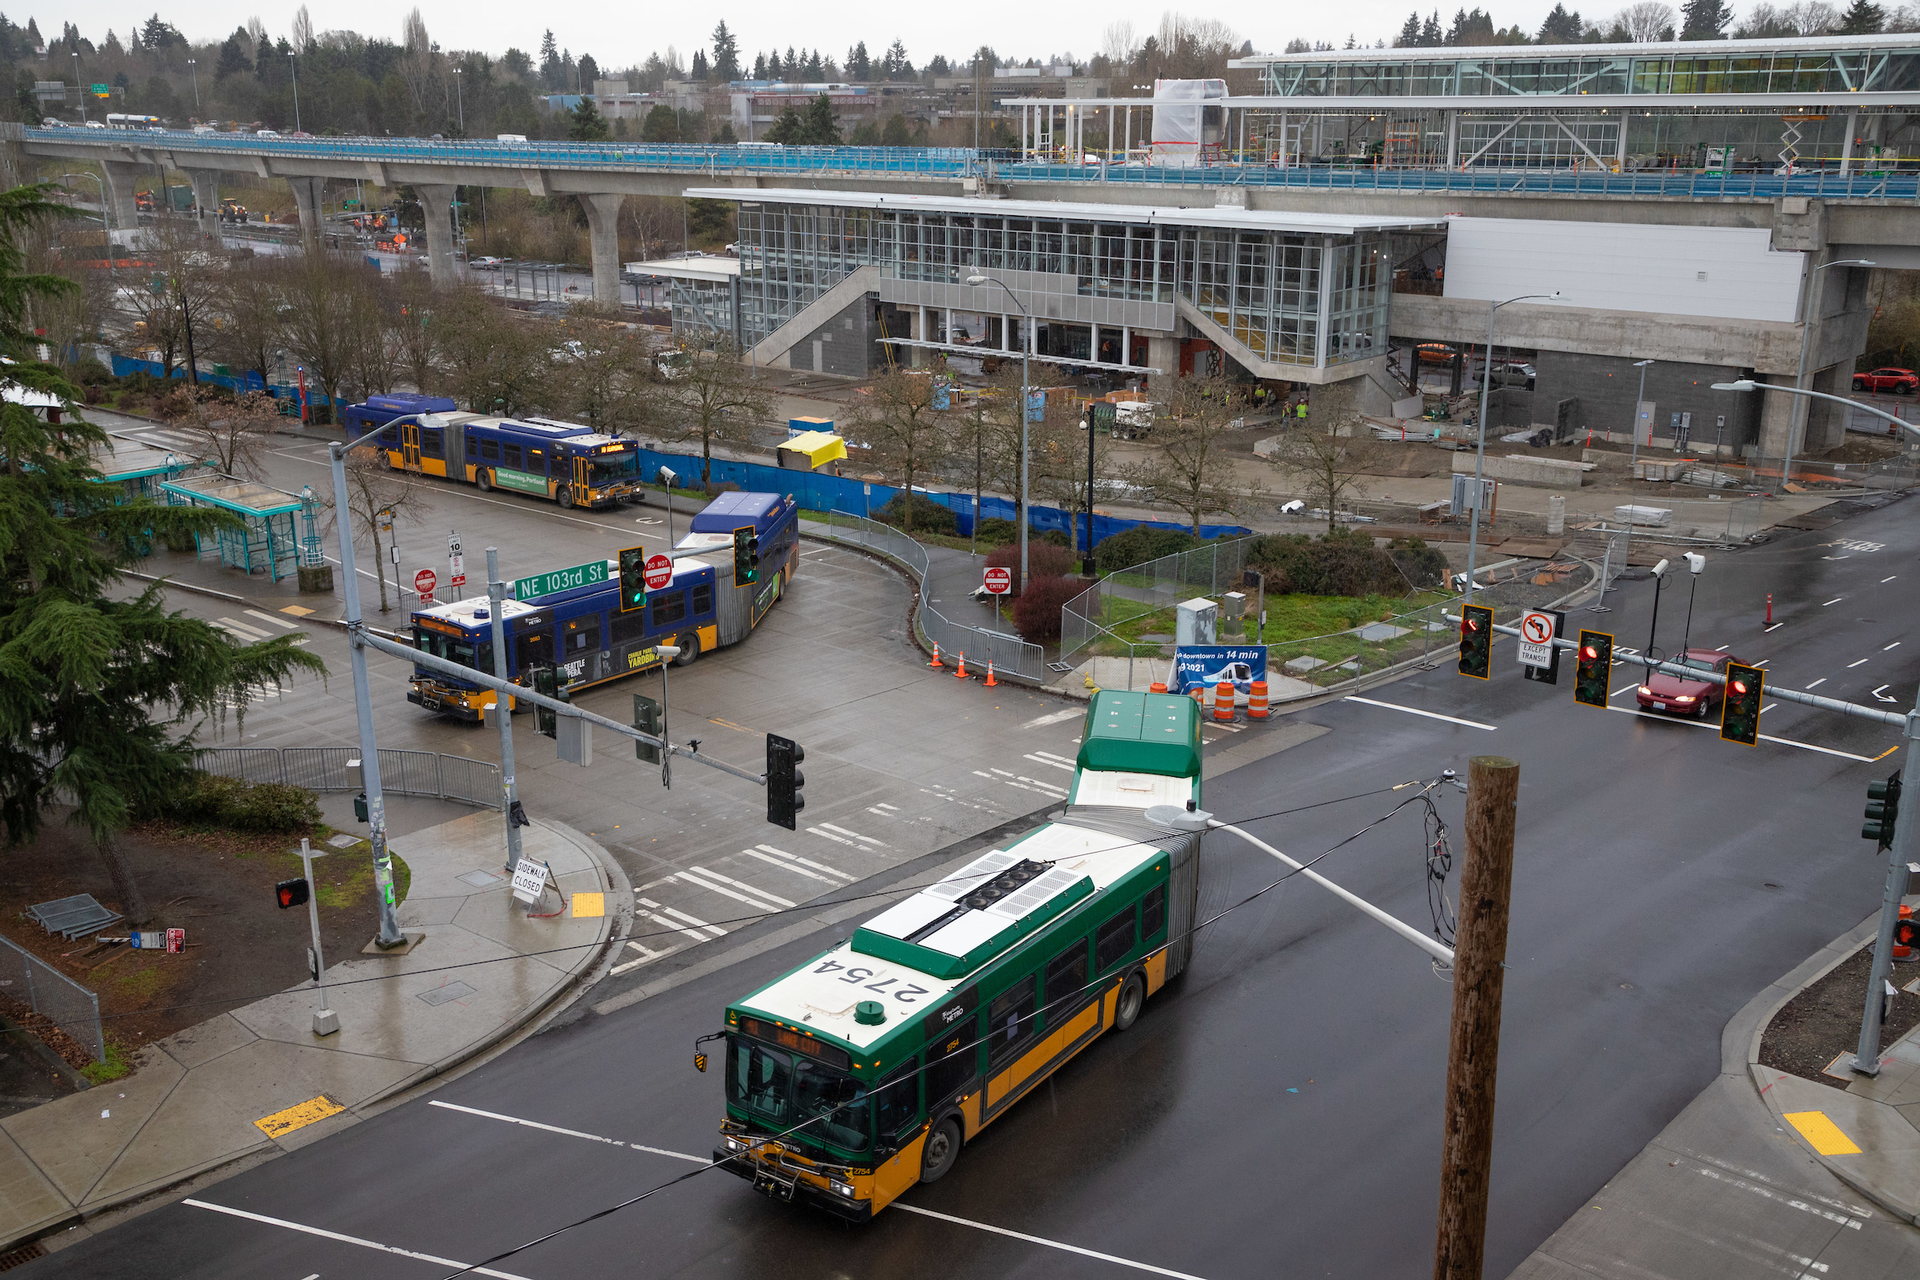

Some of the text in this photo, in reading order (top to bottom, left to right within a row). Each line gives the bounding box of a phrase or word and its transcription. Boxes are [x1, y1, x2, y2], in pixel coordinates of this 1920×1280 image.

[497, 470, 509, 478] Good
[509, 474, 526, 483] morning,
[526, 476, 546, 486] Portland!
[450, 543, 460, 551] 10
[521, 565, 602, 597] NE 103rd St
[650, 576, 667, 585] ENTER
[1226, 650, 1237, 659] 14
[1238, 650, 1258, 659] min
[1523, 643, 1546, 655] EXCEPT
[1522, 652, 1547, 663] TRANSIT
[564, 659, 585, 671] SEATTLE
[1186, 663, 1205, 672] 2021
[567, 668, 582, 679] PERA.
[517, 861, 546, 880] SIDEWALK
[514, 875, 541, 893] CLOSED
[813, 960, 930, 1003] 2754
[946, 1007, 964, 1023] METRO
[801, 1037, 821, 1056] CITY
[946, 1038, 960, 1053] 2754
[853, 1168, 871, 1176] 2754
